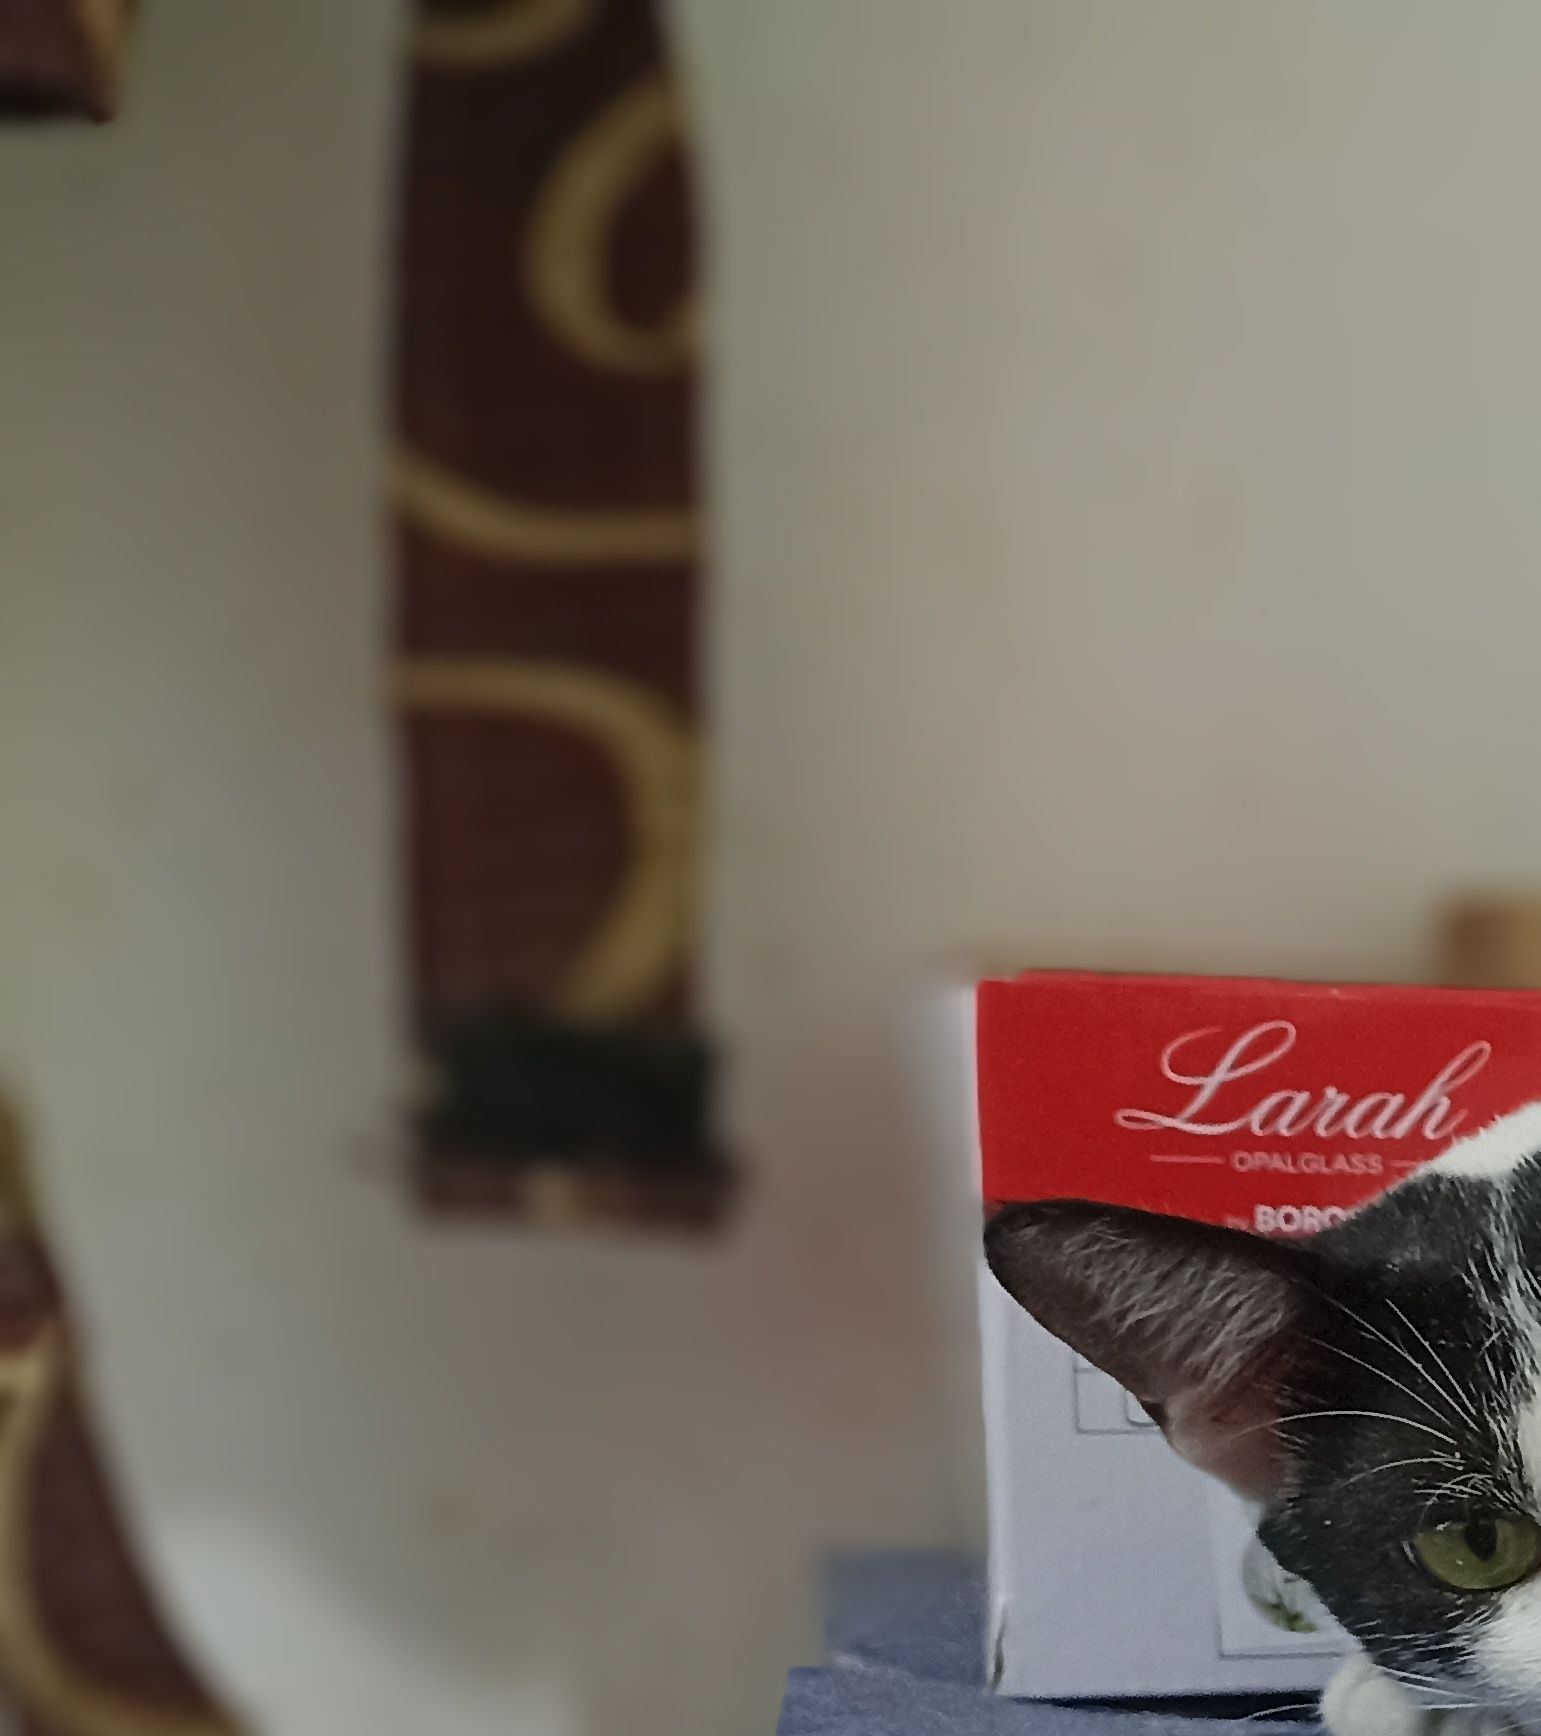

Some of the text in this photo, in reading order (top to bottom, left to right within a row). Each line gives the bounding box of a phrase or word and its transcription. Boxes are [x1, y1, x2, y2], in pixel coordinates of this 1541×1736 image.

[1115, 1020, 1492, 1141] Larah
[1231, 1151, 1384, 1176] OPALGLASS
[1254, 1203, 1349, 1233] BORO
